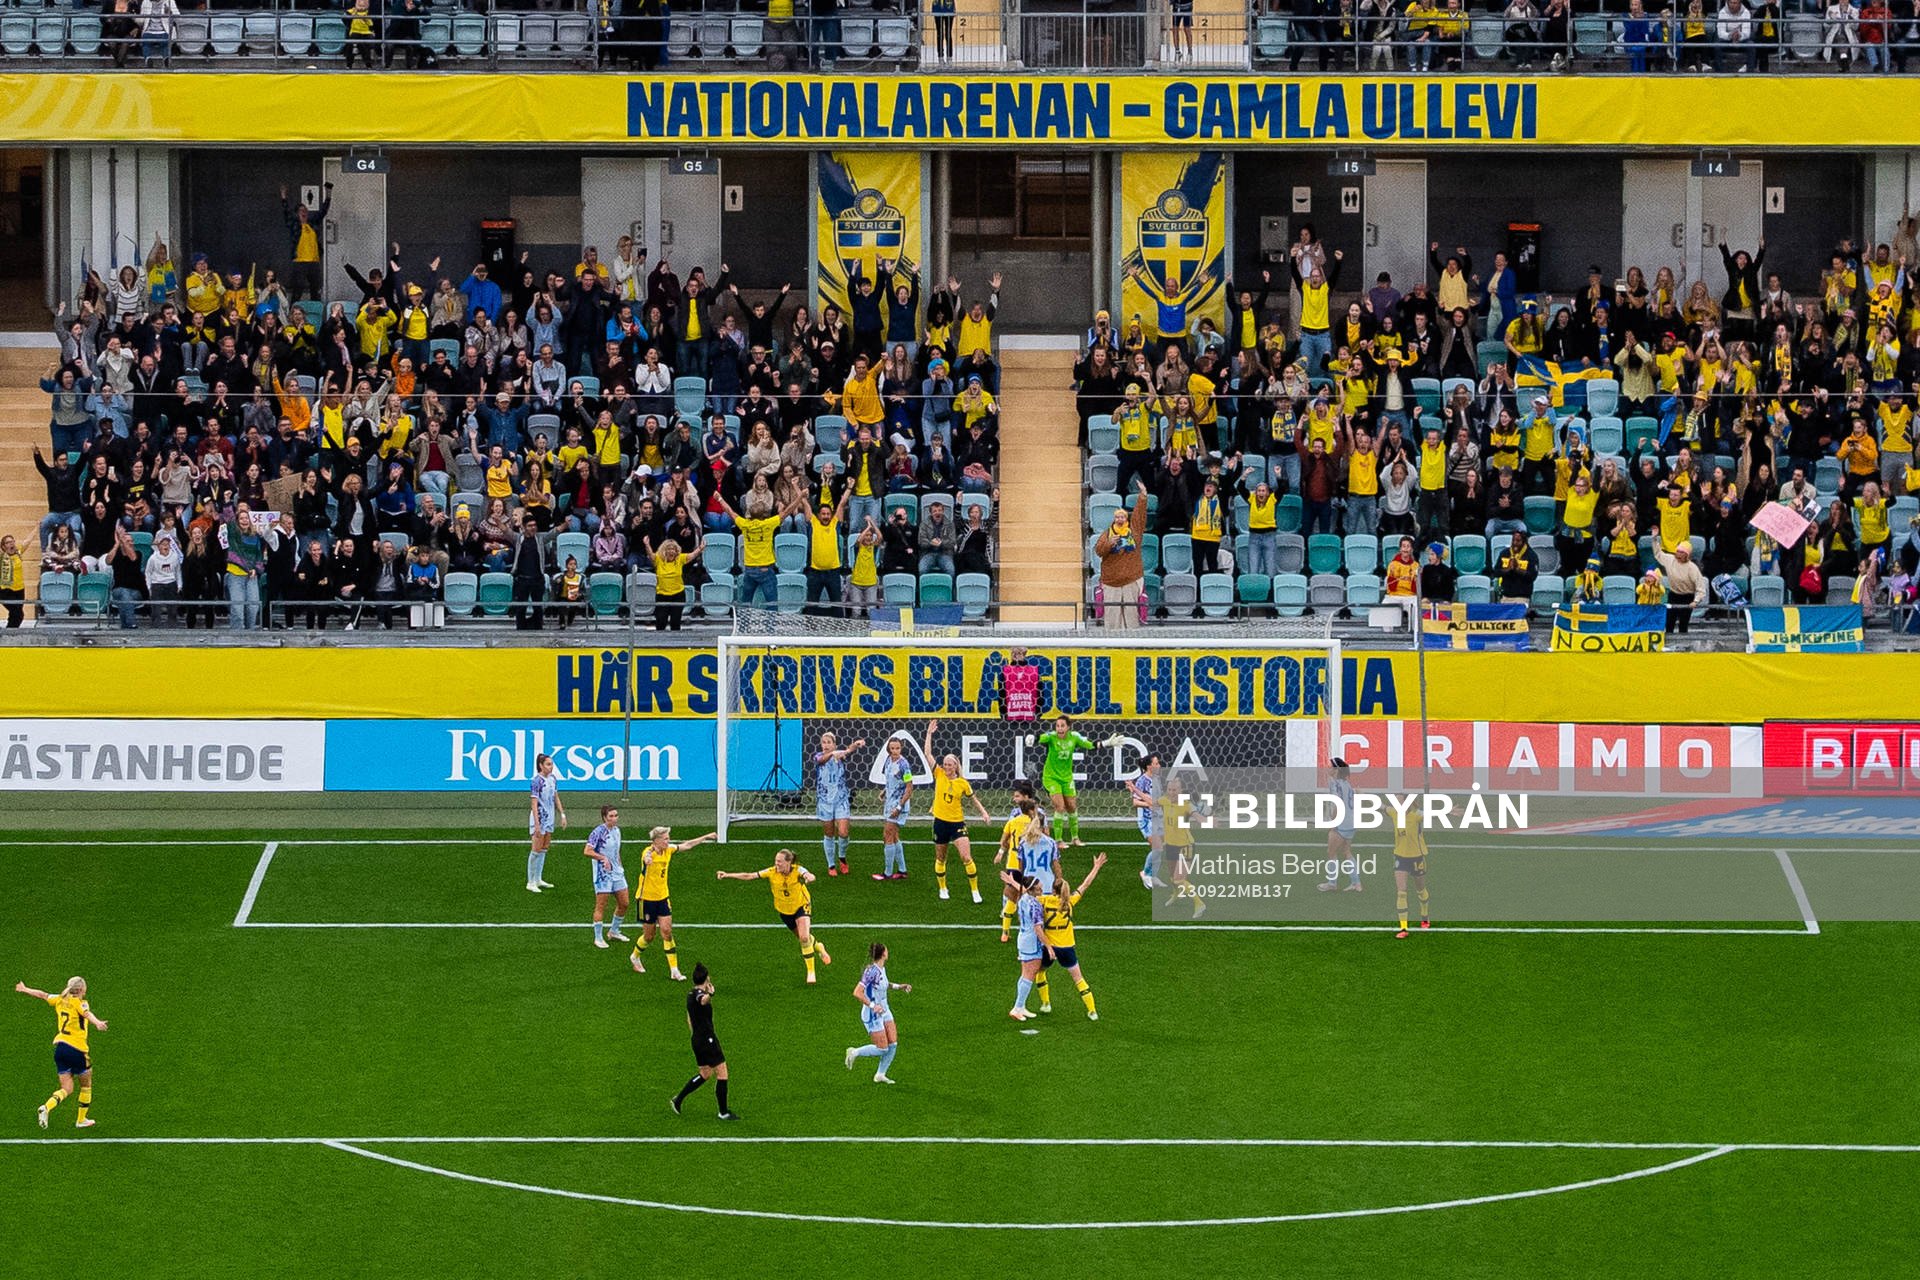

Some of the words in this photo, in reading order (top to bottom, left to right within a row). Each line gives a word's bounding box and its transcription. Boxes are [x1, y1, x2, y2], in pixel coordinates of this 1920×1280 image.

[627, 81, 1111, 138] NATIONALARENAN
[1164, 82, 1350, 139] GAMLA
[1362, 83, 1537, 139] ULLEVI
[357, 159, 376, 170] G4
[683, 160, 703, 172] G5
[844, 221, 895, 230] SVERIGE
[1148, 222, 1198, 231] SVERIGE
[557, 650, 674, 714] HÄR
[687, 653, 895, 714] SKRIVS
[1135, 656, 1399, 716] HISTORIA
[1, 734, 284, 781] ÄSTANHEDE
[444, 729, 682, 782] Folksam
[1339, 733, 1714, 778] CRAMO
[1027, 849, 1049, 872] 14
[1044, 907, 1071, 931] 23
